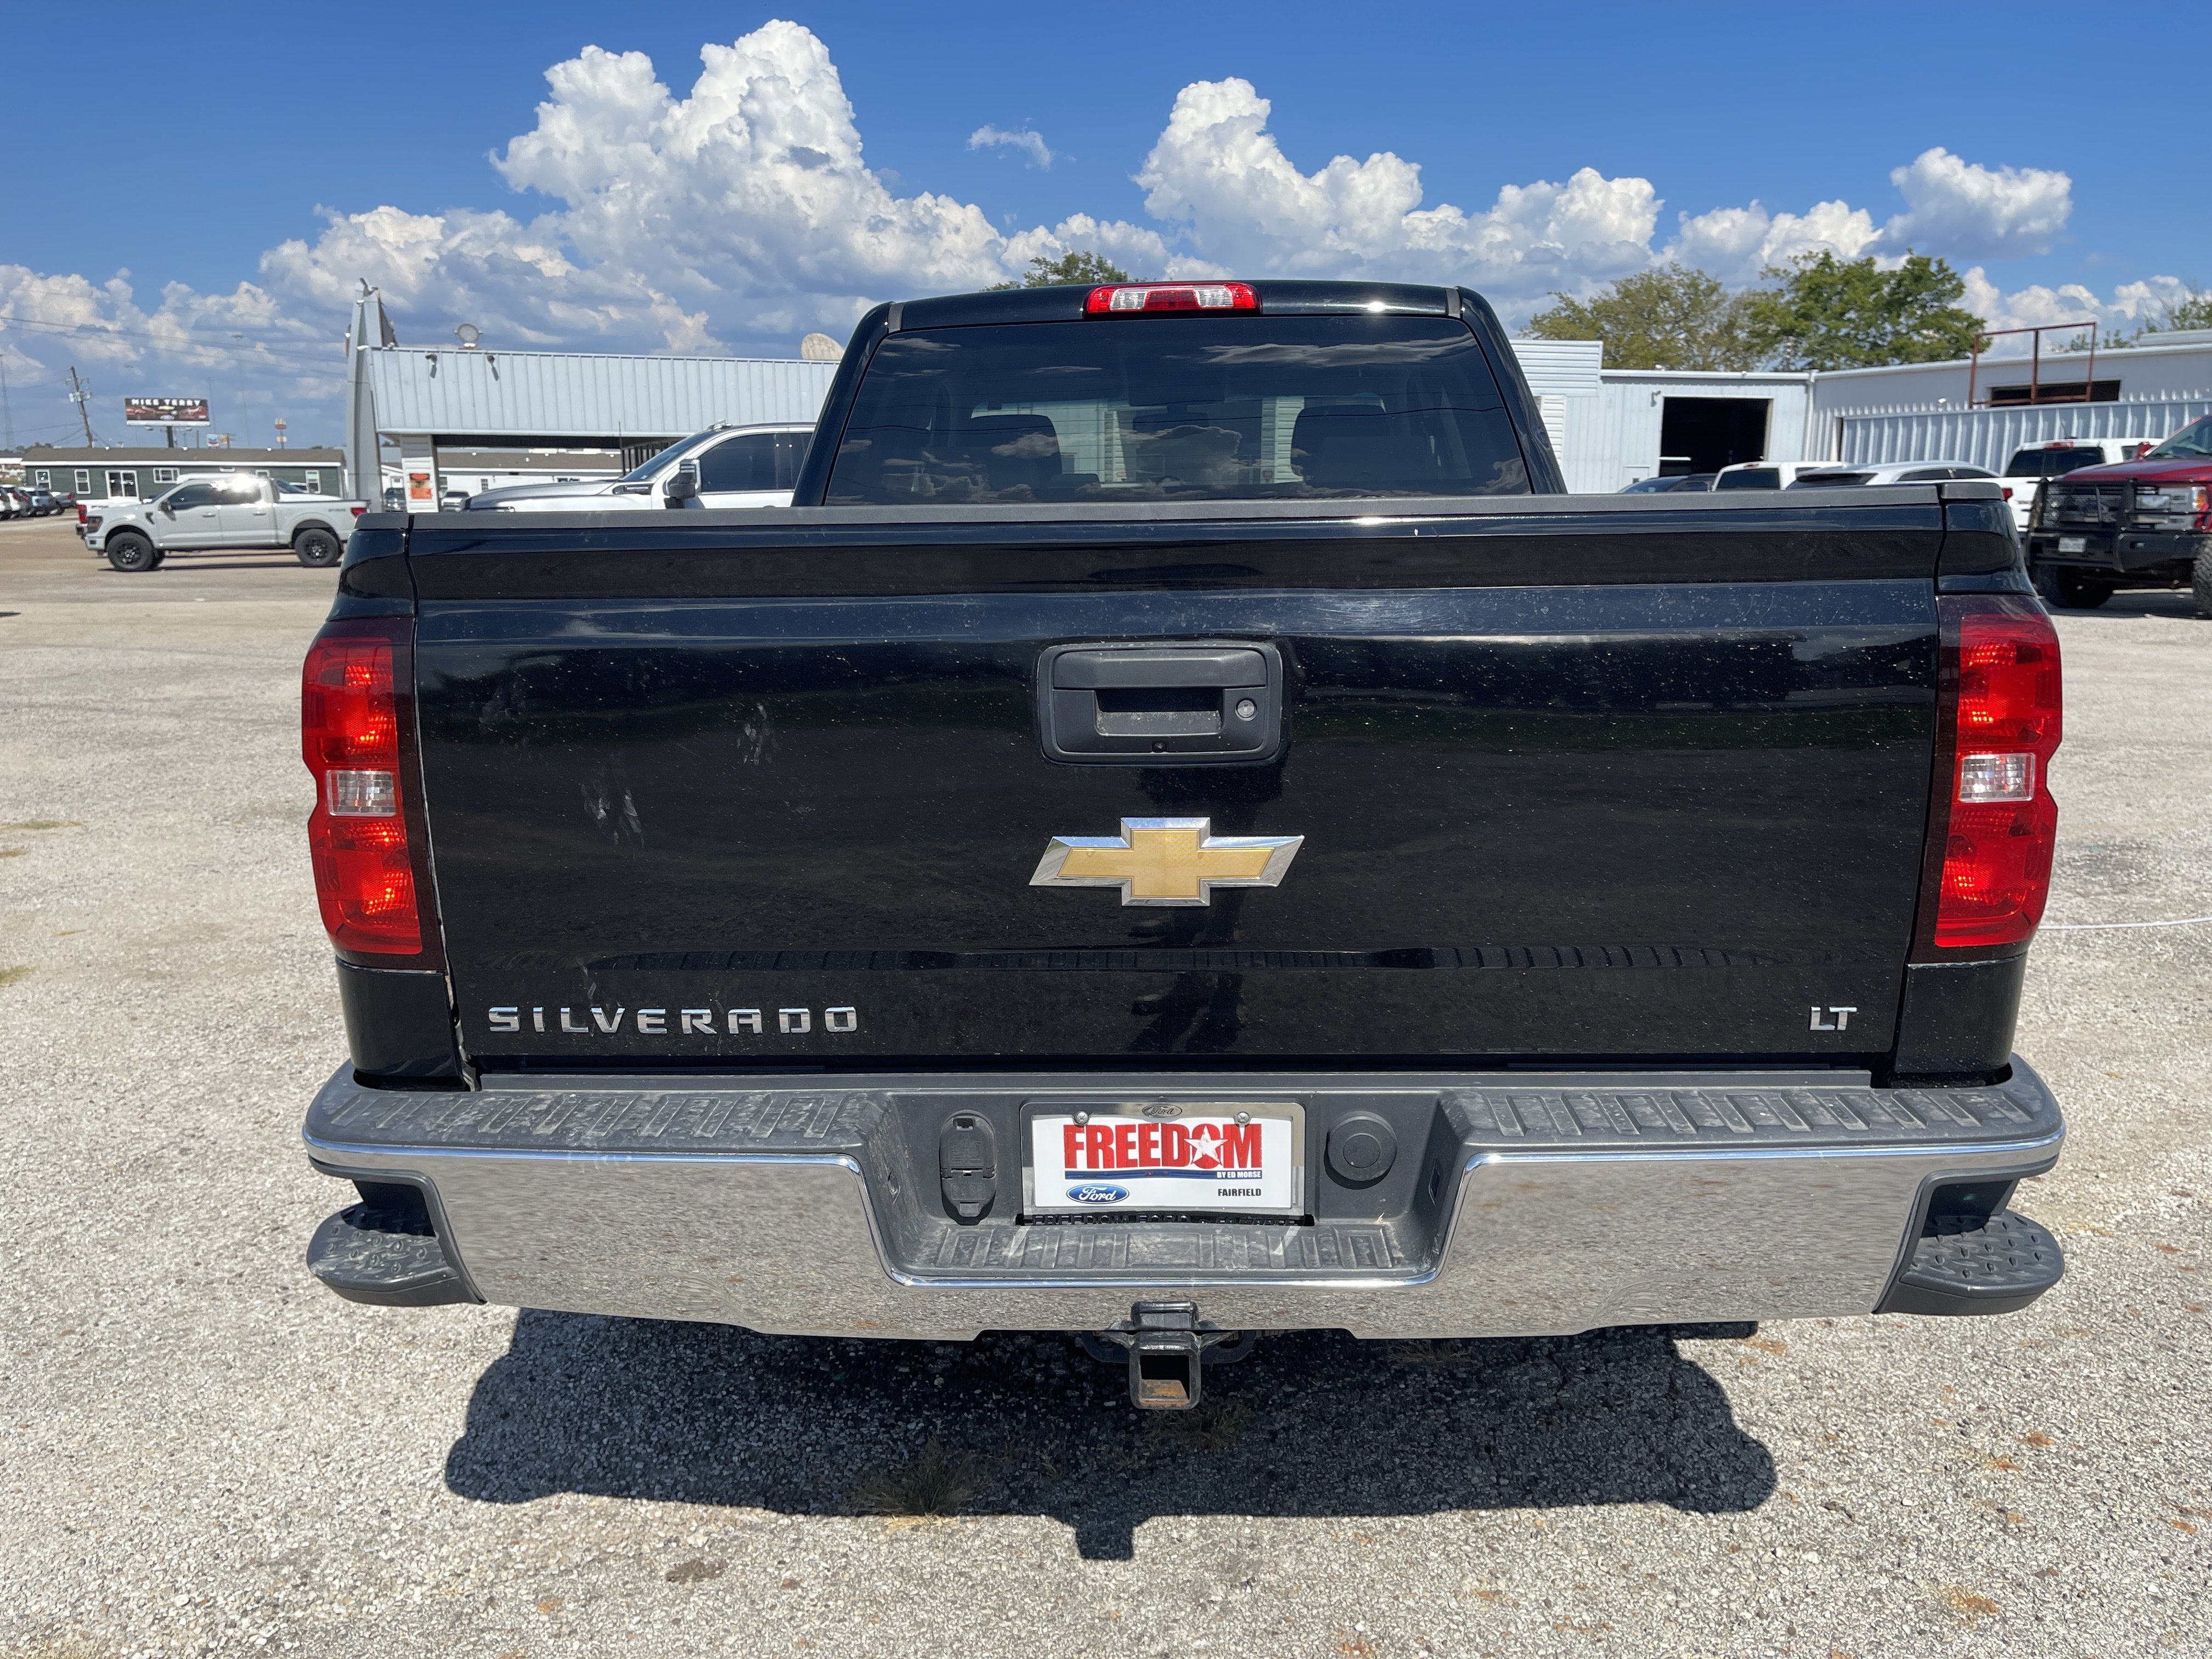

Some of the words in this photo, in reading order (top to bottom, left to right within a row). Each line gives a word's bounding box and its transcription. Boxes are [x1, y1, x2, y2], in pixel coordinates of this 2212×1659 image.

[488, 1006, 858, 1035] SILVERADO
[1810, 1006, 1858, 1031] LT
[1150, 1105, 1175, 1115] Ford
[1063, 1123, 1262, 1169] FREEDOM
[1079, 1186, 1117, 1201] Ford
[1217, 1188, 1262, 1197] FAIRFIELD
